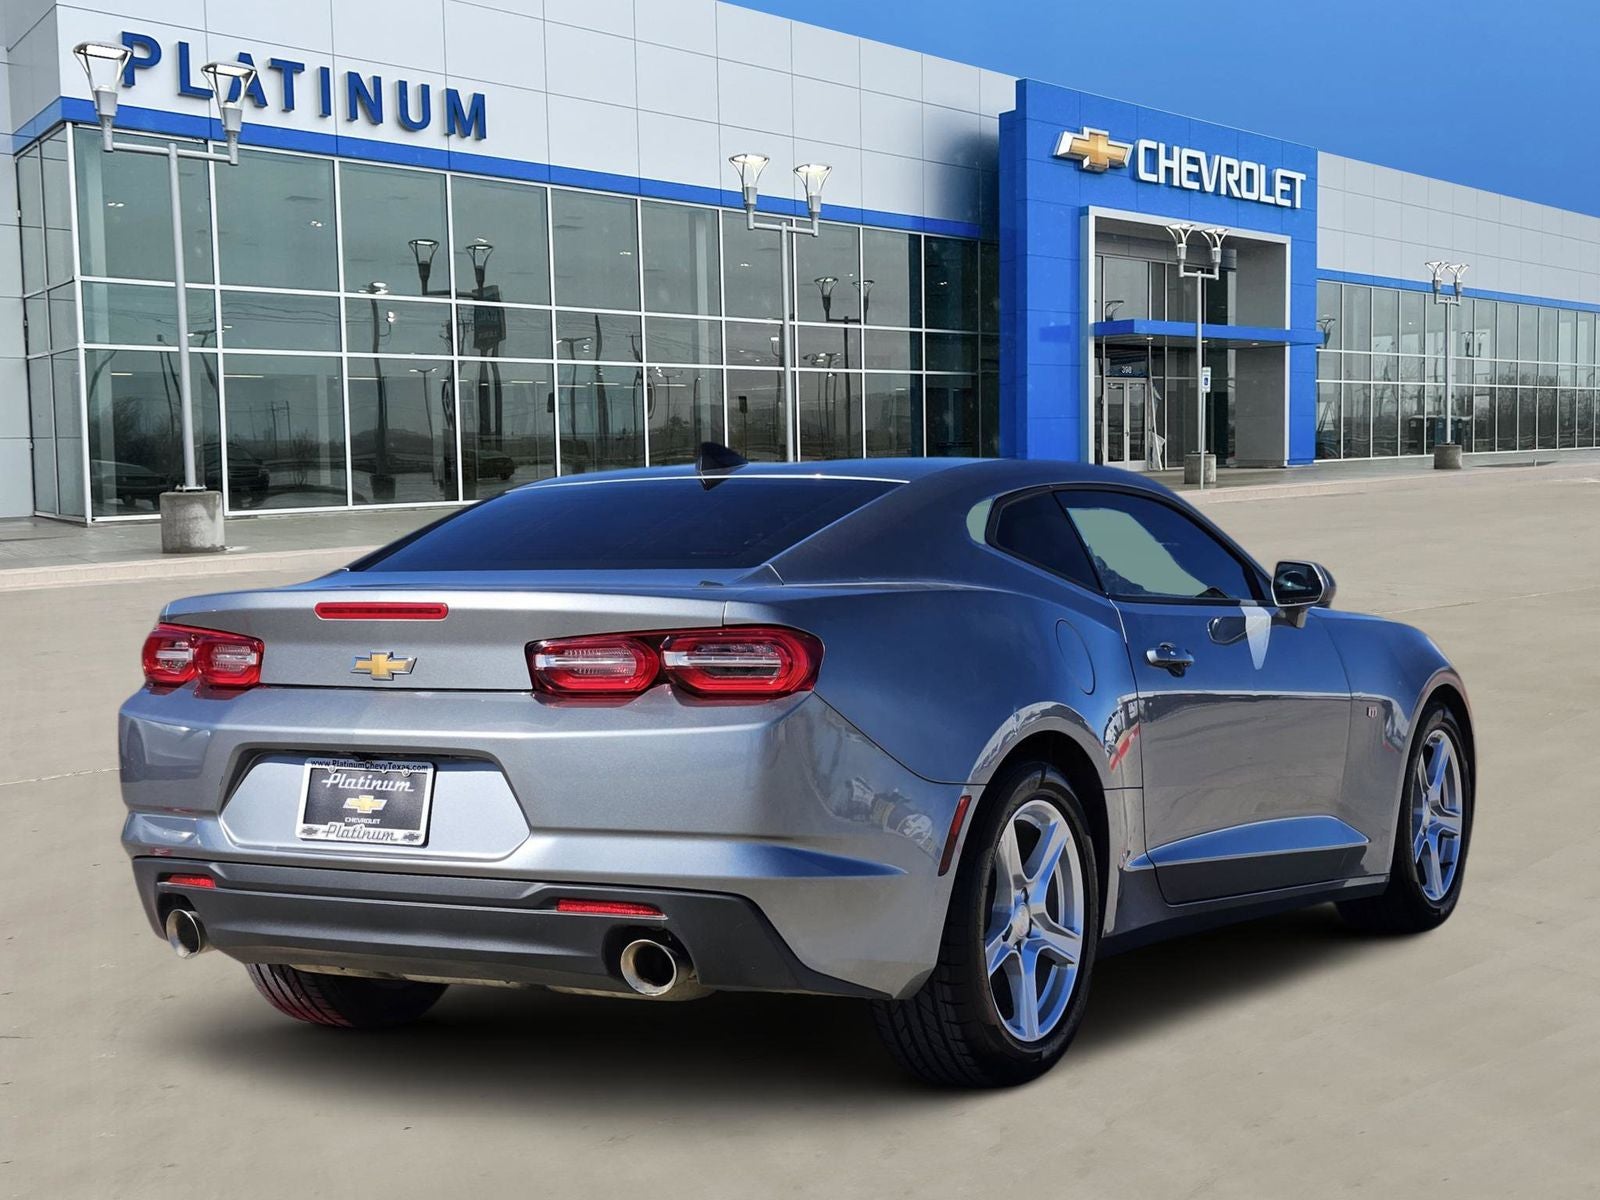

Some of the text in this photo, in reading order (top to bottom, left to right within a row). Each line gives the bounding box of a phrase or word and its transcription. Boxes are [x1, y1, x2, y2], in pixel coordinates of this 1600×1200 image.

[121, 31, 487, 140] PLATINUM
[1136, 138, 1307, 209] CHEVROLET
[310, 759, 429, 771] www.PlatinumChevyTexas.com
[321, 772, 415, 792] Platinum
[344, 816, 381, 825] CHEVROLET
[321, 824, 399, 841] Platinum
